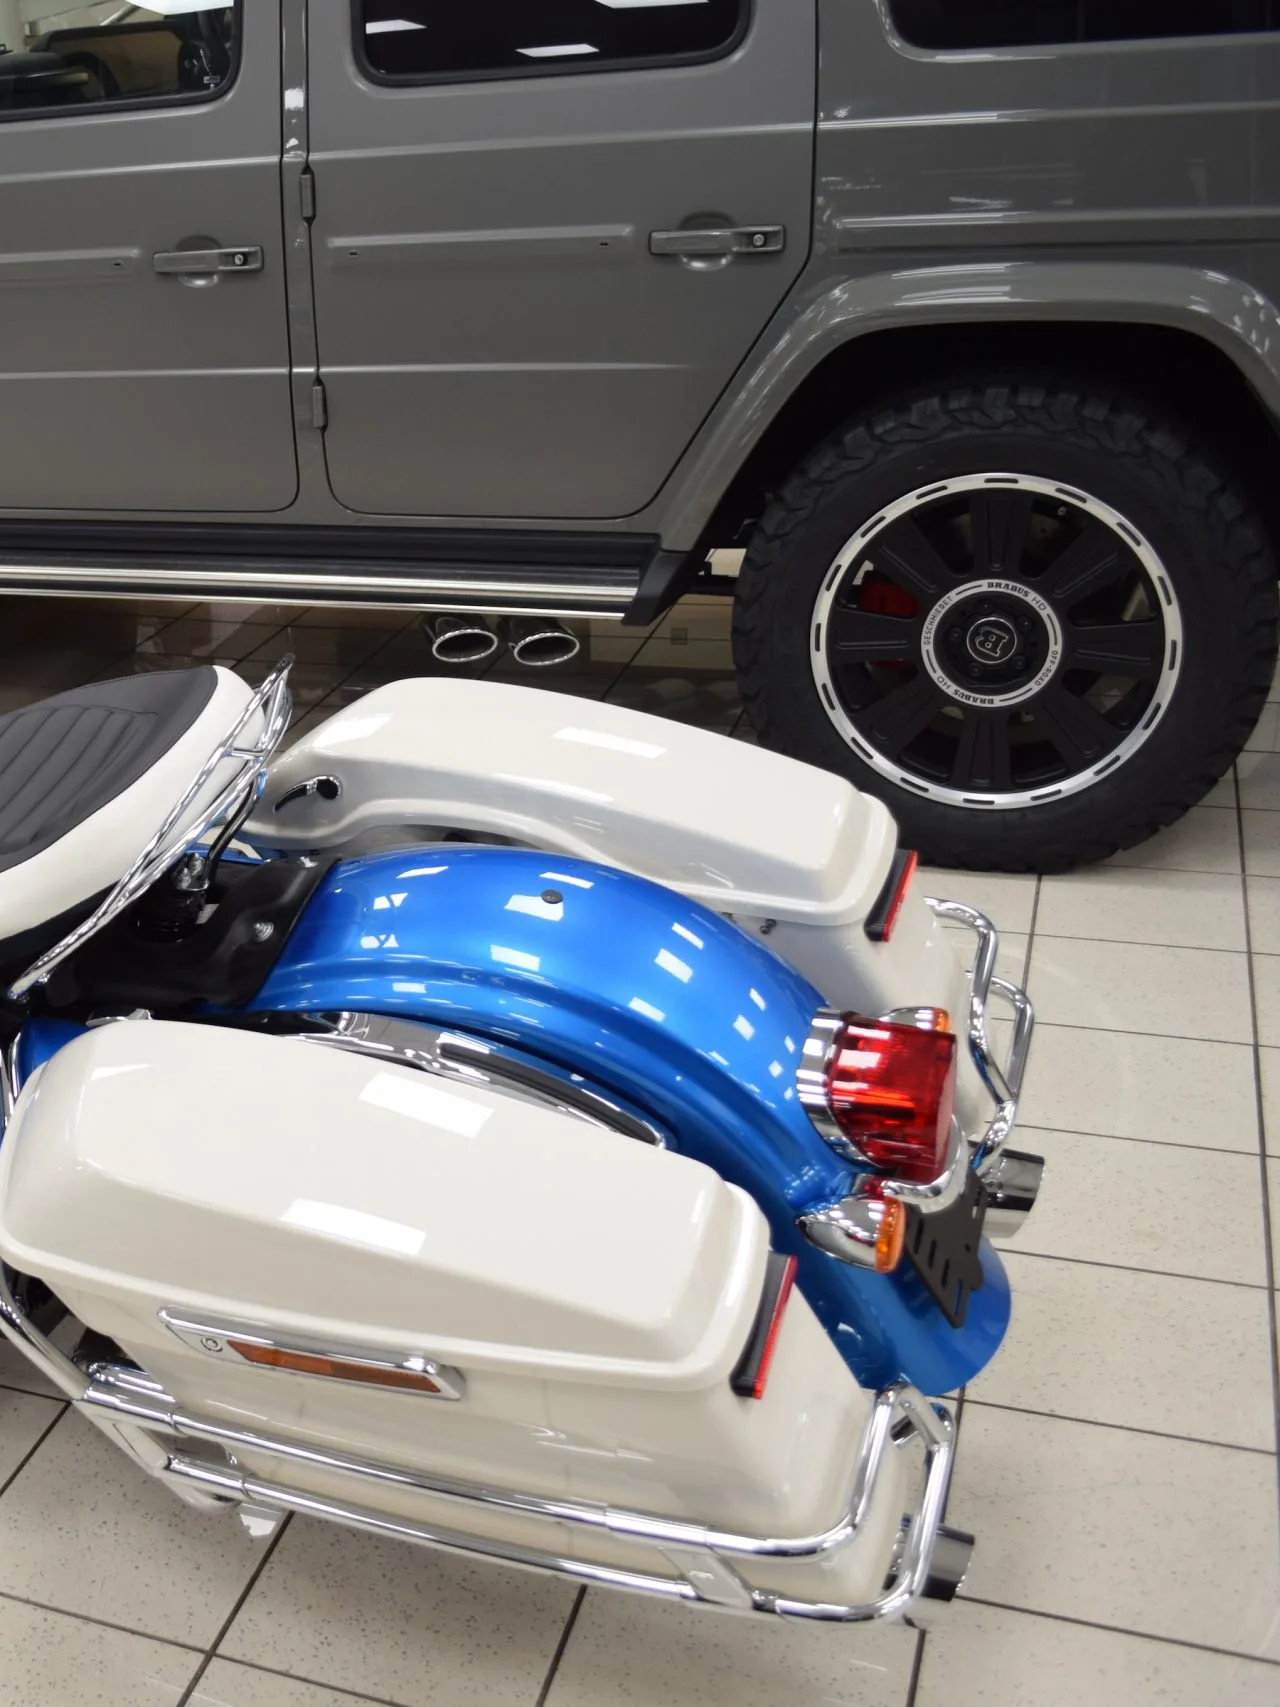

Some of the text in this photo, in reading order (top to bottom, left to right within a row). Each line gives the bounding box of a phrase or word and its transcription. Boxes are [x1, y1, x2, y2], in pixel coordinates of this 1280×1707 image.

[986, 581, 1048, 612] BRABUS HD
[1034, 649, 1059, 687] OFF-ROAD
[936, 675, 995, 705] BRABUS HD
